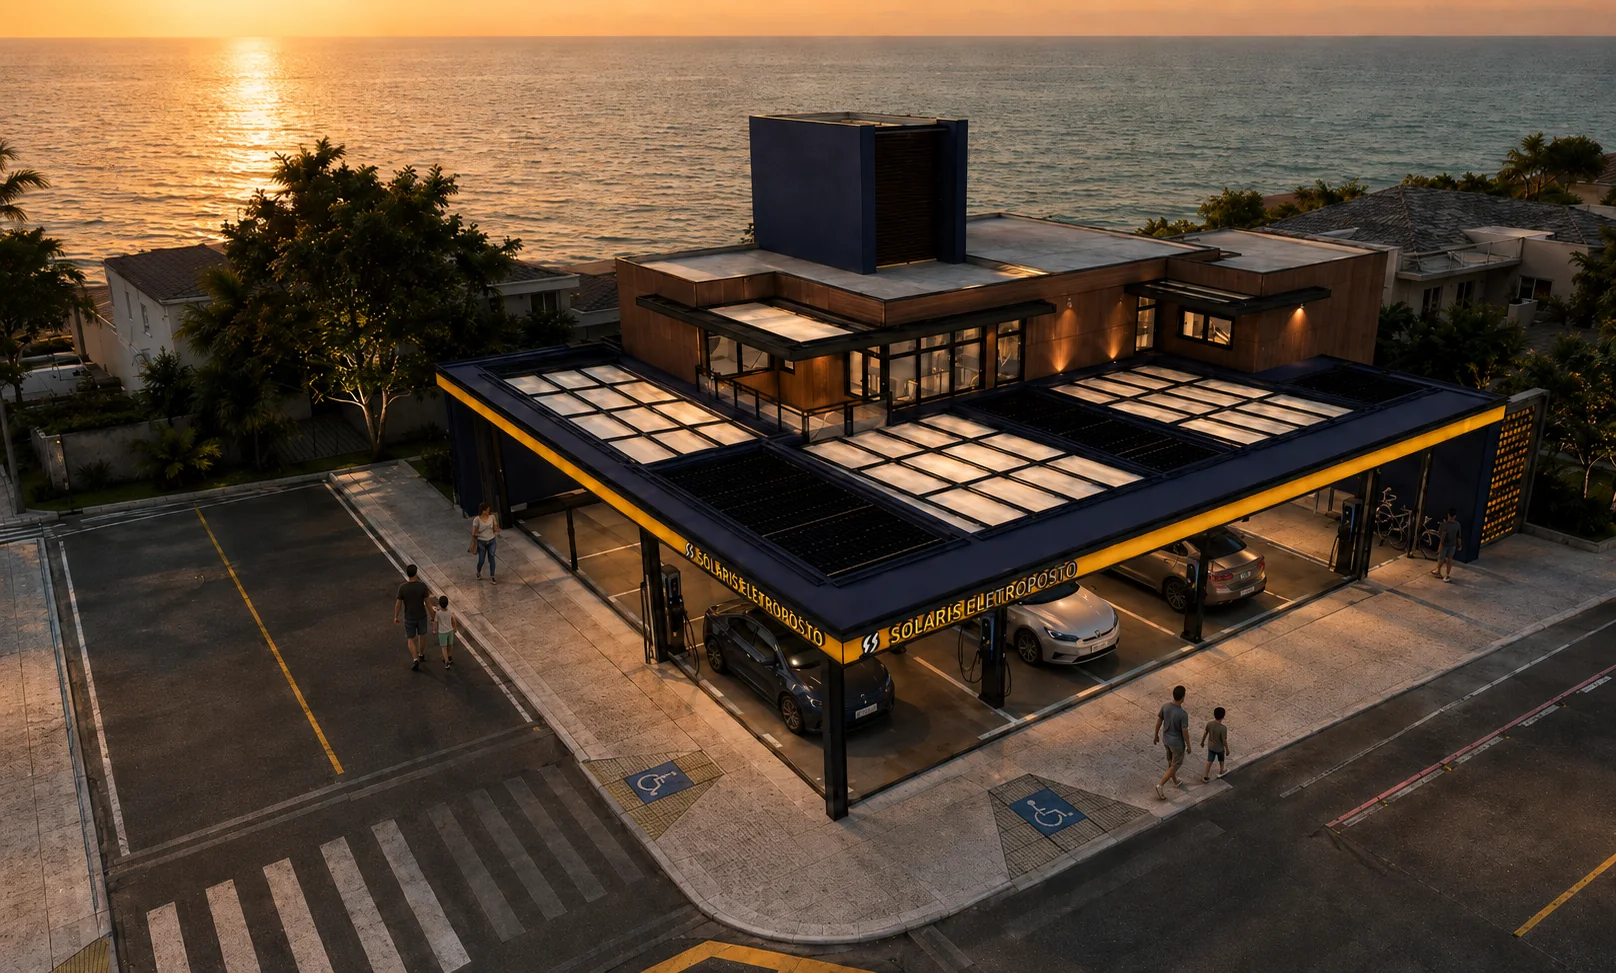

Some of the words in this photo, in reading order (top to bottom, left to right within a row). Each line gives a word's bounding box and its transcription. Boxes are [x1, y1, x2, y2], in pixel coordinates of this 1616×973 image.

[696, 551, 738, 591] SOLARIS
[741, 580, 823, 646] ELETROPOSTO
[890, 602, 961, 644] SOLARIS
[966, 561, 1078, 615] ELETROPOSTO
